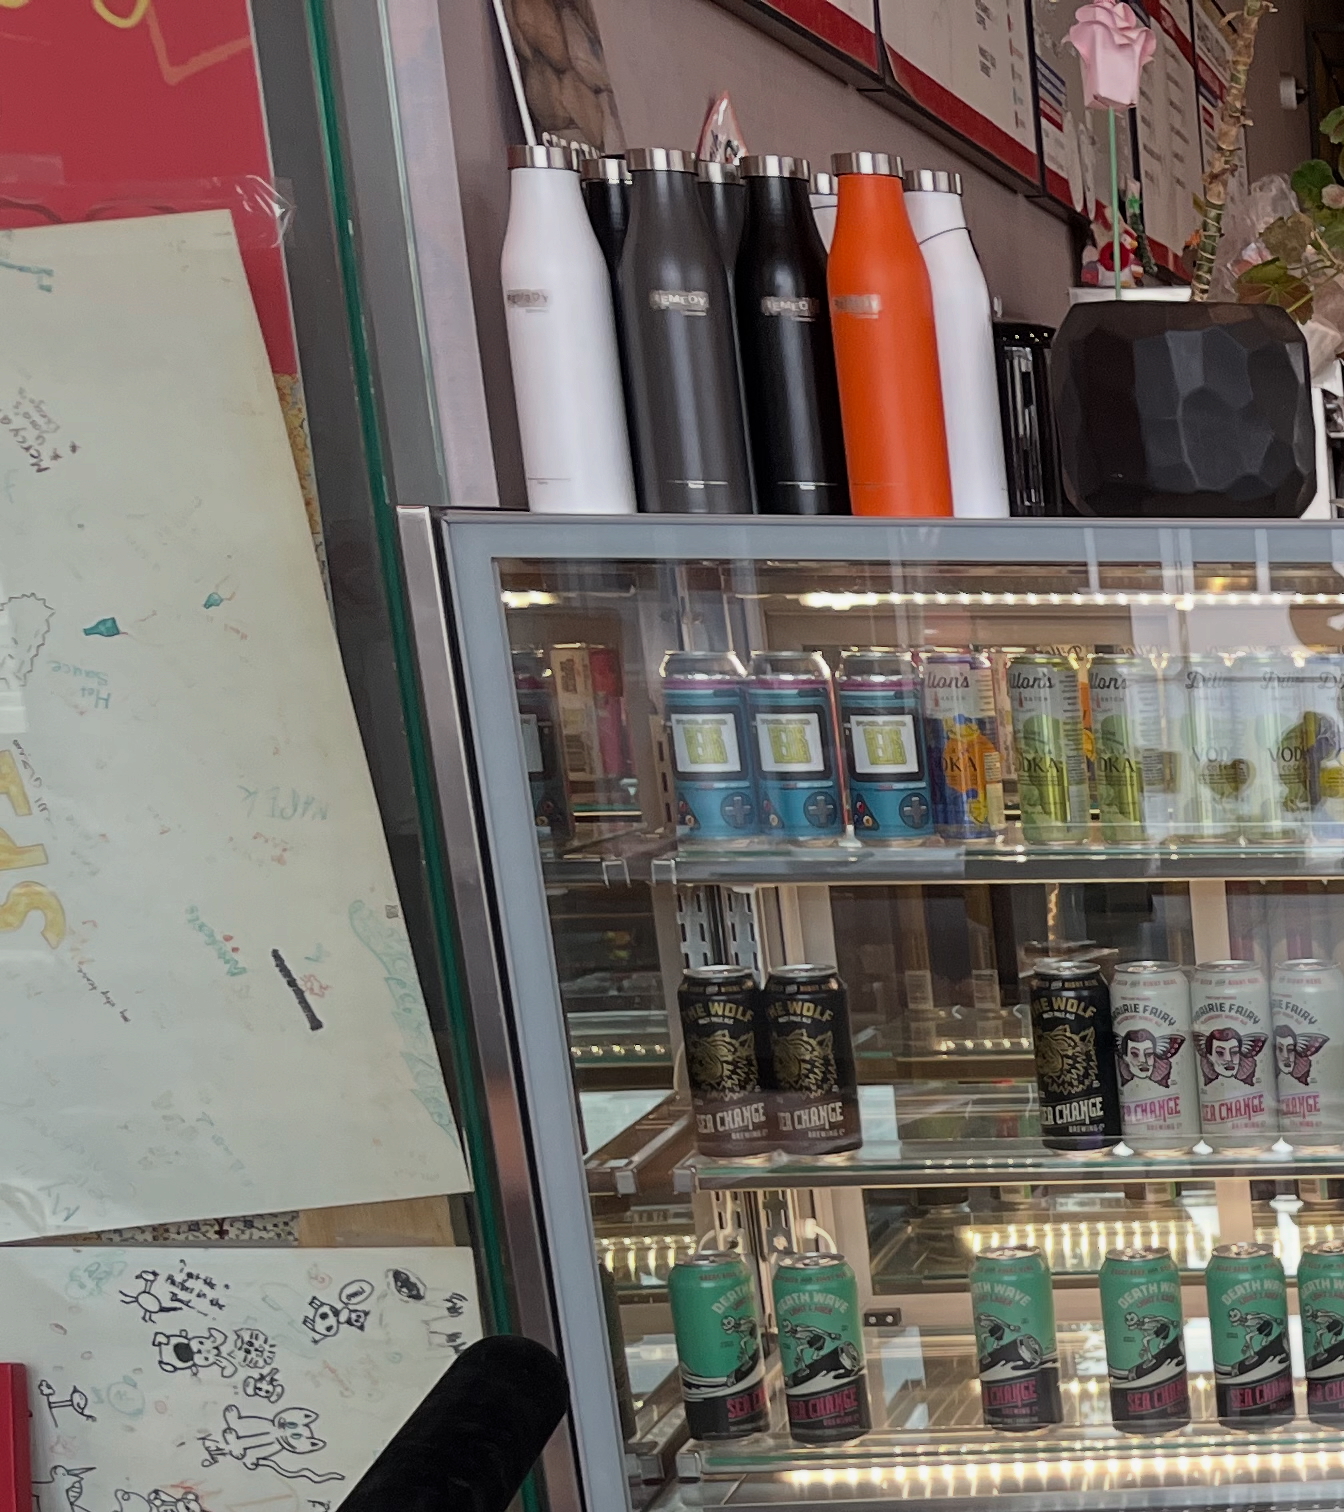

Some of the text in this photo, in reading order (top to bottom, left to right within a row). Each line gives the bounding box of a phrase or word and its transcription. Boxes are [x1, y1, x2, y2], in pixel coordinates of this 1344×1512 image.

[51, 661, 108, 686] Sauce
[927, 673, 970, 689] llon's
[709, 1002, 754, 1021] WOLF
[788, 1001, 833, 1021] WOLF
[1053, 997, 1097, 1018] WOLF
[1143, 1005, 1176, 1026] FAIRY
[1229, 1004, 1260, 1026] FAIRY
[1285, 1003, 1317, 1025] FAIRY
[716, 1103, 766, 1131] CHANGE
[794, 1102, 843, 1129] CHANGE
[1056, 1098, 1103, 1124] CHANGE
[1130, 1096, 1180, 1124] CHANGE
[1219, 1095, 1264, 1123] CHANGE
[813, 1292, 848, 1312] WAVE
[993, 1284, 1031, 1306] WAVE
[1118, 1284, 1159, 1309] DEATH
[1222, 1279, 1261, 1305] DEATH
[809, 1387, 857, 1419] CHANGE
[989, 1380, 1037, 1407] CHANGE
[1127, 1392, 1149, 1411] SEA
[1231, 1389, 1253, 1409] SEA
